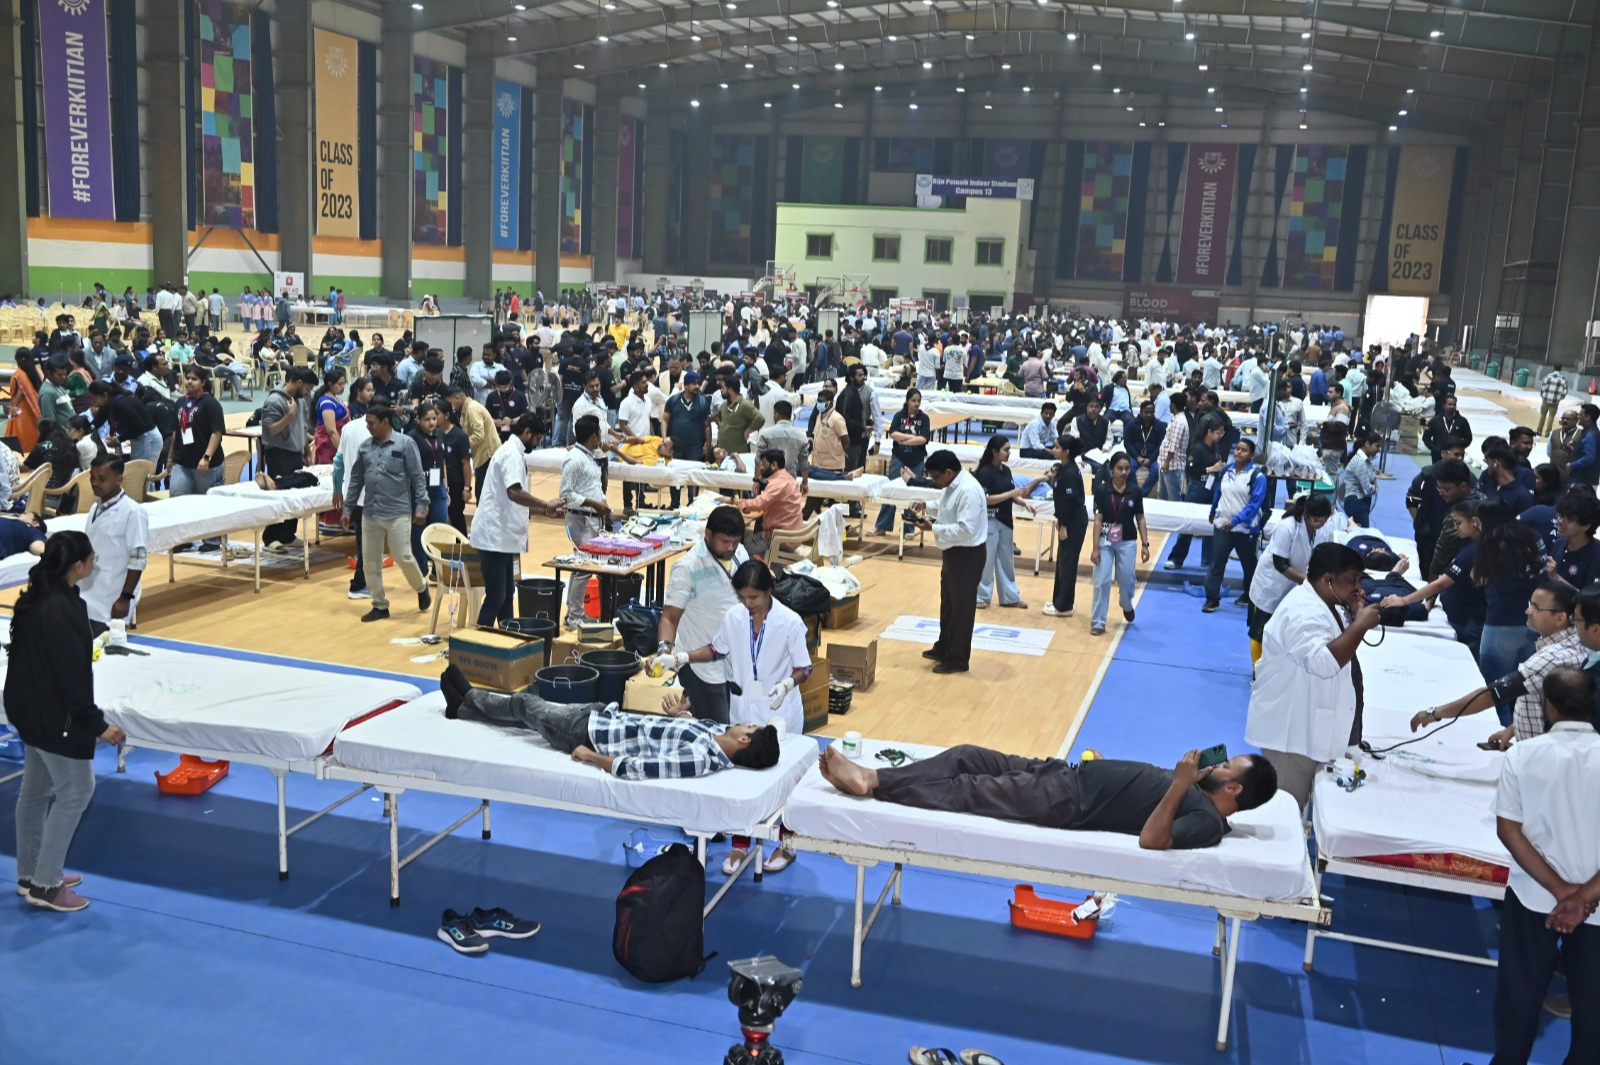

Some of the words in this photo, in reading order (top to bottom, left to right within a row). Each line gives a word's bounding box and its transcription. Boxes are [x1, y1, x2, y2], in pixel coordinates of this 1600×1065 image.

[65, 31, 91, 203] #FOREVERKIITIAN
[319, 140, 354, 166] CLASS
[320, 167, 334, 190] OF
[500, 128, 510, 237] #FOREVERKIITIAN
[945, 178, 969, 186] Patnaik
[969, 179, 991, 187] Indoor
[991, 180, 1018, 188] Stadium
[955, 188, 984, 196] Campus
[321, 192, 353, 219] 2023
[1195, 181, 1217, 276] #FOREVERKIITIAN
[1396, 223, 1439, 241] CLASS
[1393, 243, 1411, 260] OF
[1391, 260, 1433, 281] 2023
[1129, 297, 1168, 308] BLOOD
[473, 660, 498, 671] BLOOD
